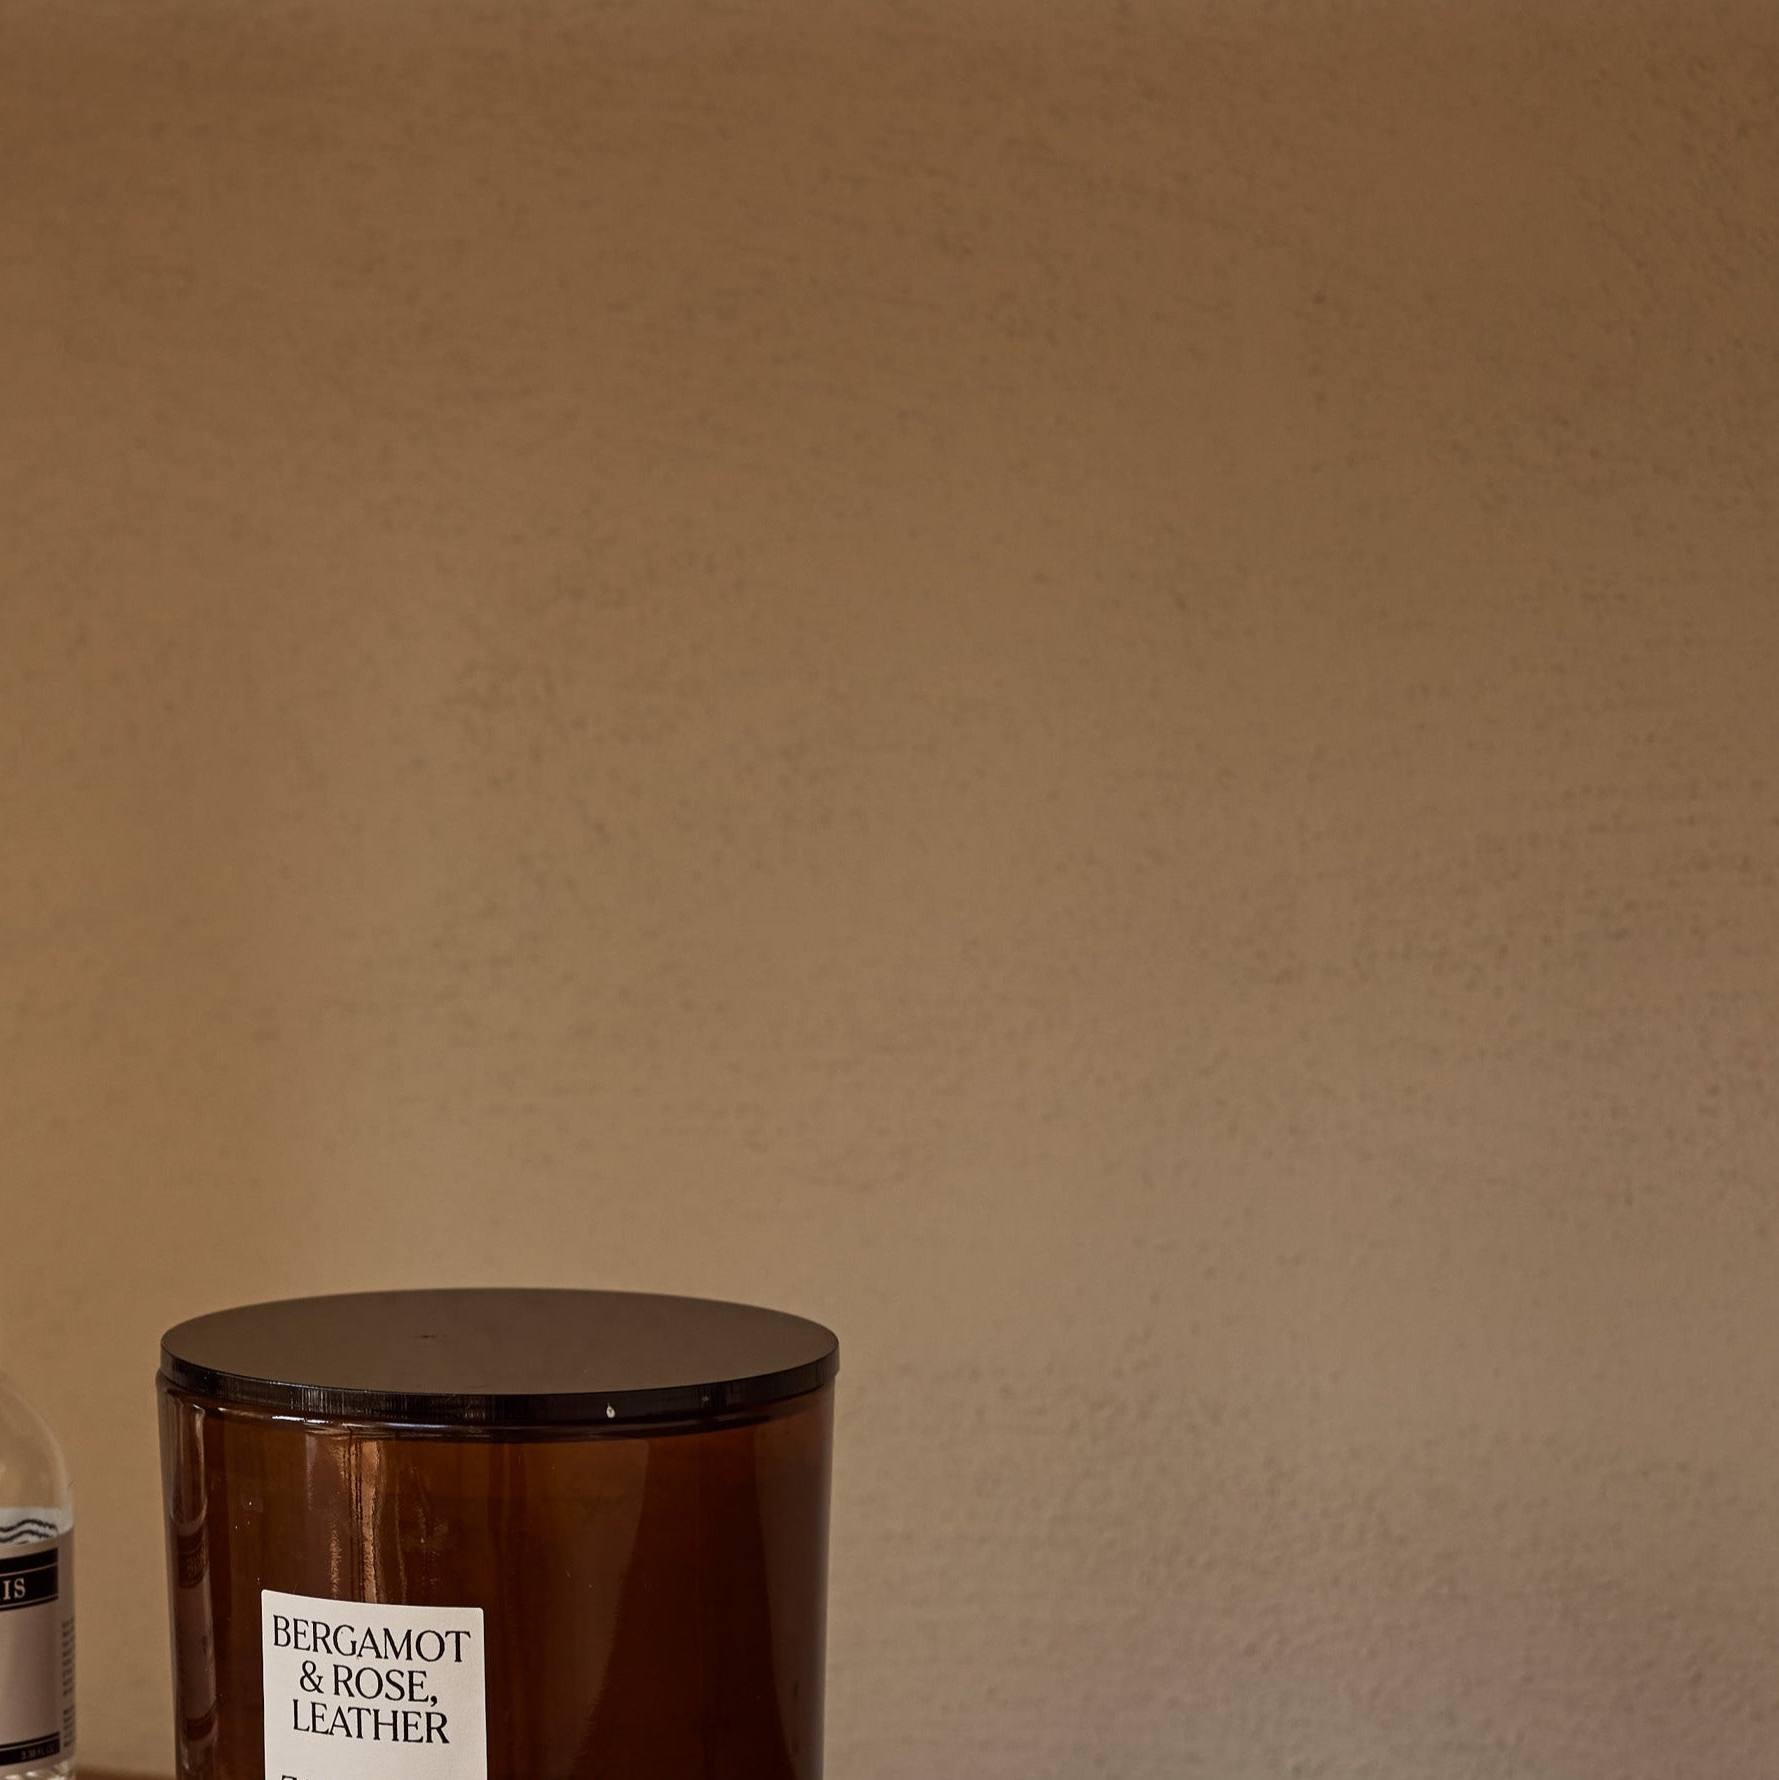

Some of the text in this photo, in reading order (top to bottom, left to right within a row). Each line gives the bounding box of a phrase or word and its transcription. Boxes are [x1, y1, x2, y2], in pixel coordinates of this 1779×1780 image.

[273, 1614, 471, 1663] BERGAMOT
[299, 1660, 438, 1707] & ROSE,
[292, 1698, 450, 1744] LEATHER
